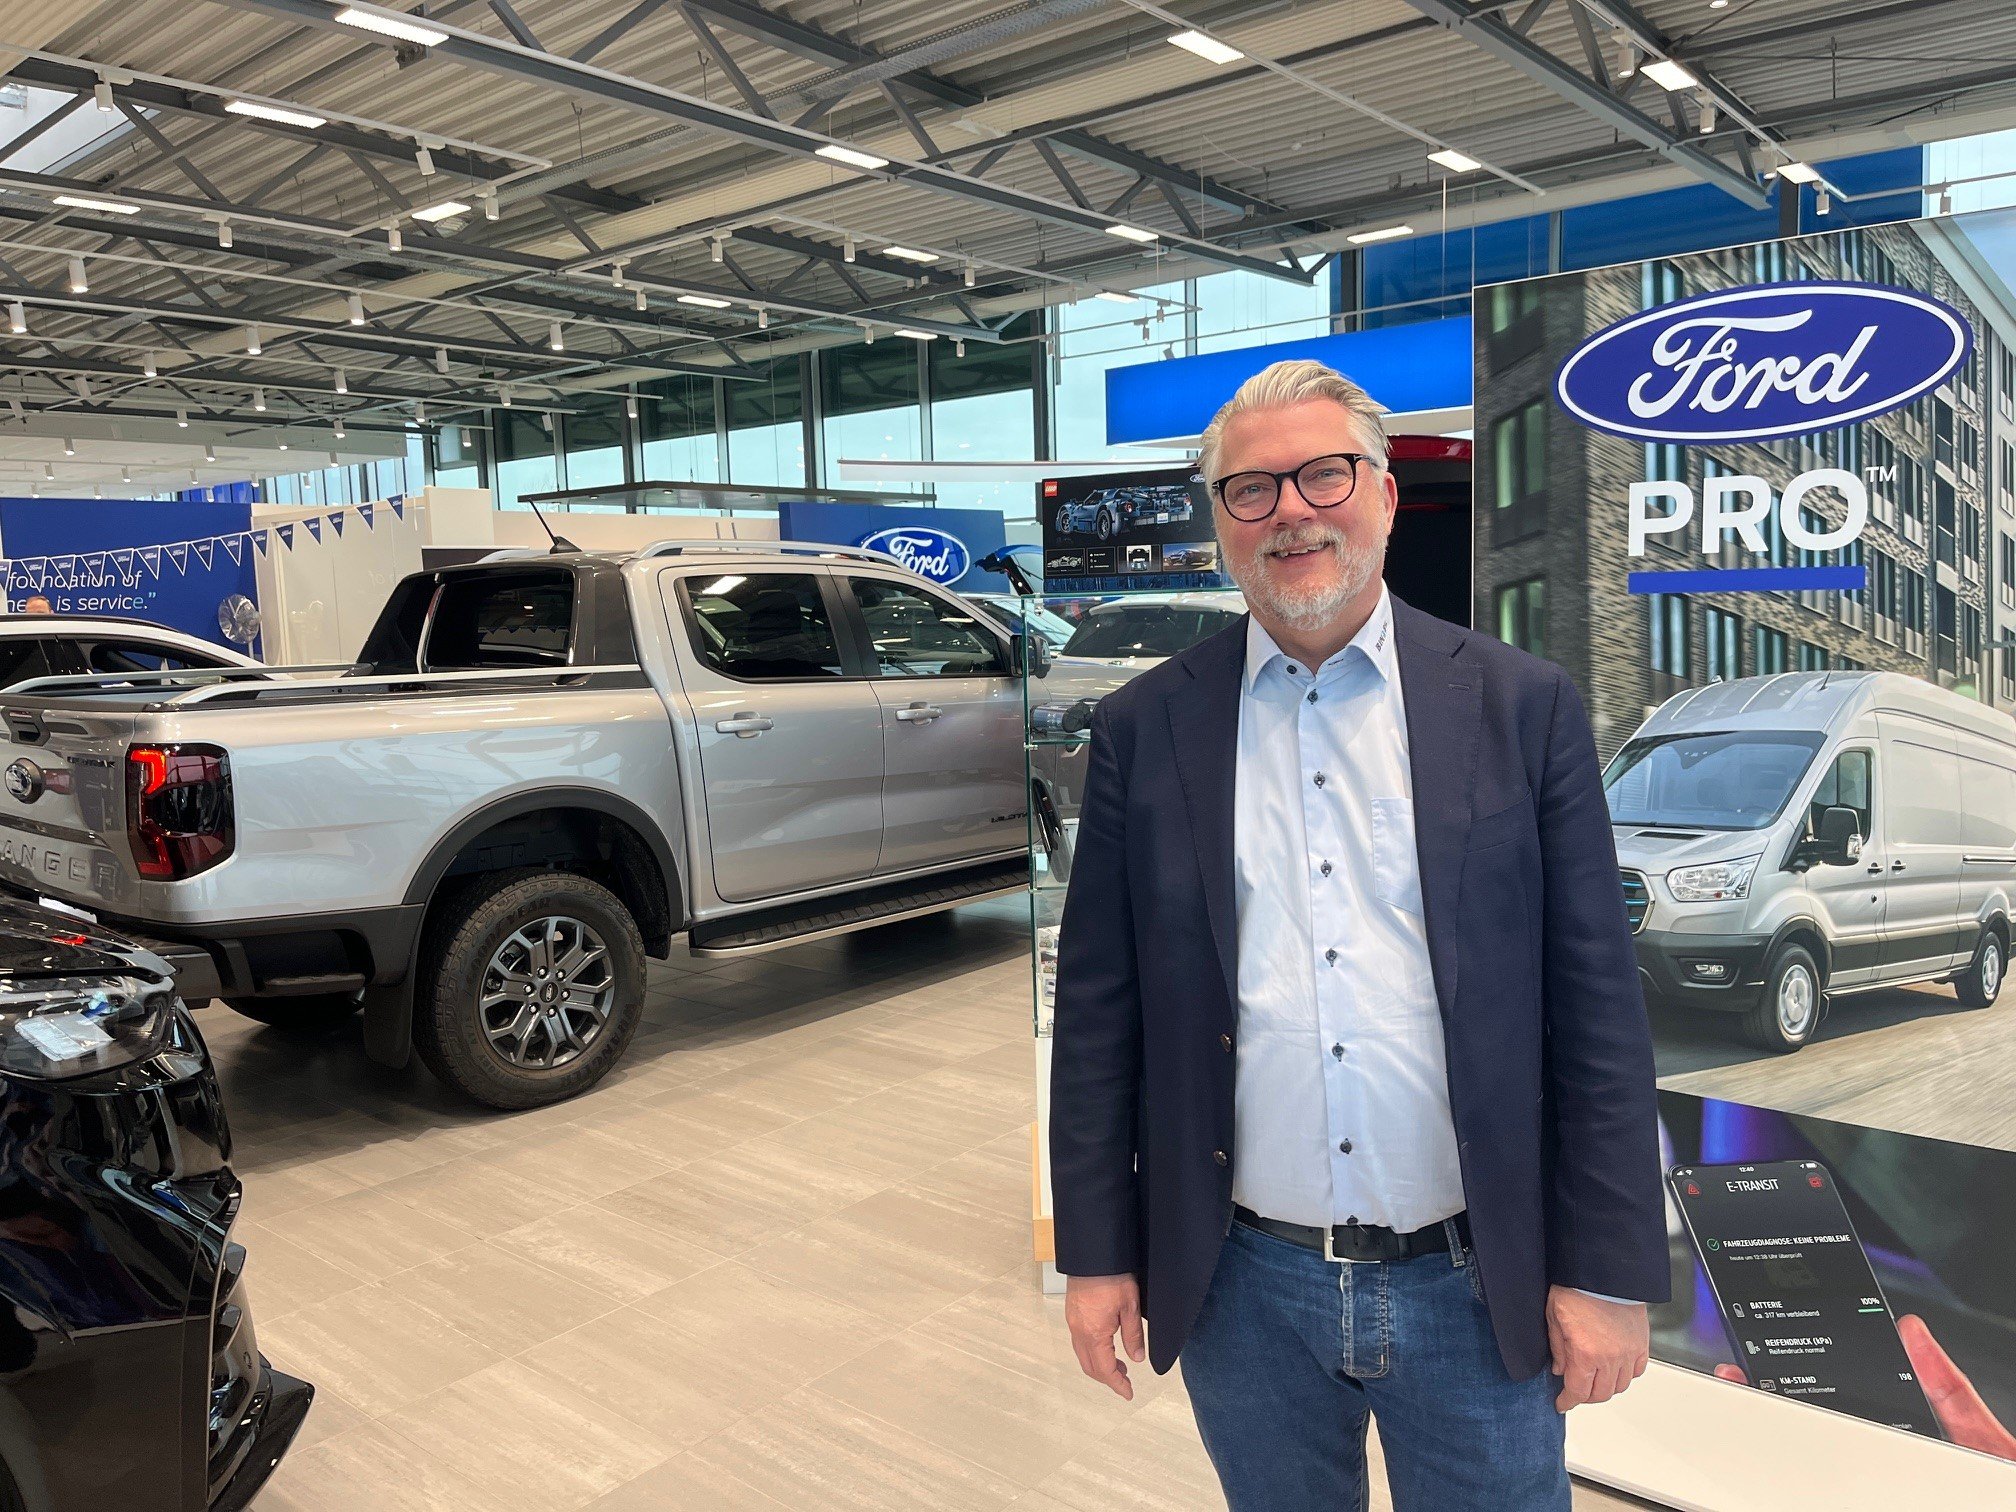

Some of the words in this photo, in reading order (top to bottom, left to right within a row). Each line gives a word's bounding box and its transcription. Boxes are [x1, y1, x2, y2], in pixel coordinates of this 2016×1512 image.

[1626, 308, 1879, 418] Ford
[1628, 468, 1867, 556] PRO
[889, 536, 950, 575] Ford
[122, 570, 143, 590] of
[56, 595, 71, 611] is
[1726, 1178, 1780, 1193] E-TRANSIT
[1722, 1237, 1793, 1248] FAHRZEUGDIAGNOSE:
[1793, 1236, 1815, 1246] KEINE
[1814, 1234, 1851, 1244] PROBLEME
[1750, 1301, 1783, 1310] BATTERIE
[1860, 1297, 1880, 1305] 100%
[1786, 1310, 1820, 1318] verbleibend
[1764, 1338, 1812, 1347] REIFENDRUCK
[1812, 1337, 1833, 1346] (kPa)
[1768, 1347, 1804, 1355] Reifendruck
[1779, 1376, 1817, 1385] KM-STAND
[1898, 1373, 1913, 1381] 198
[1784, 1387, 1808, 1395] Gesamt
[1808, 1386, 1836, 1394] Kilometer
